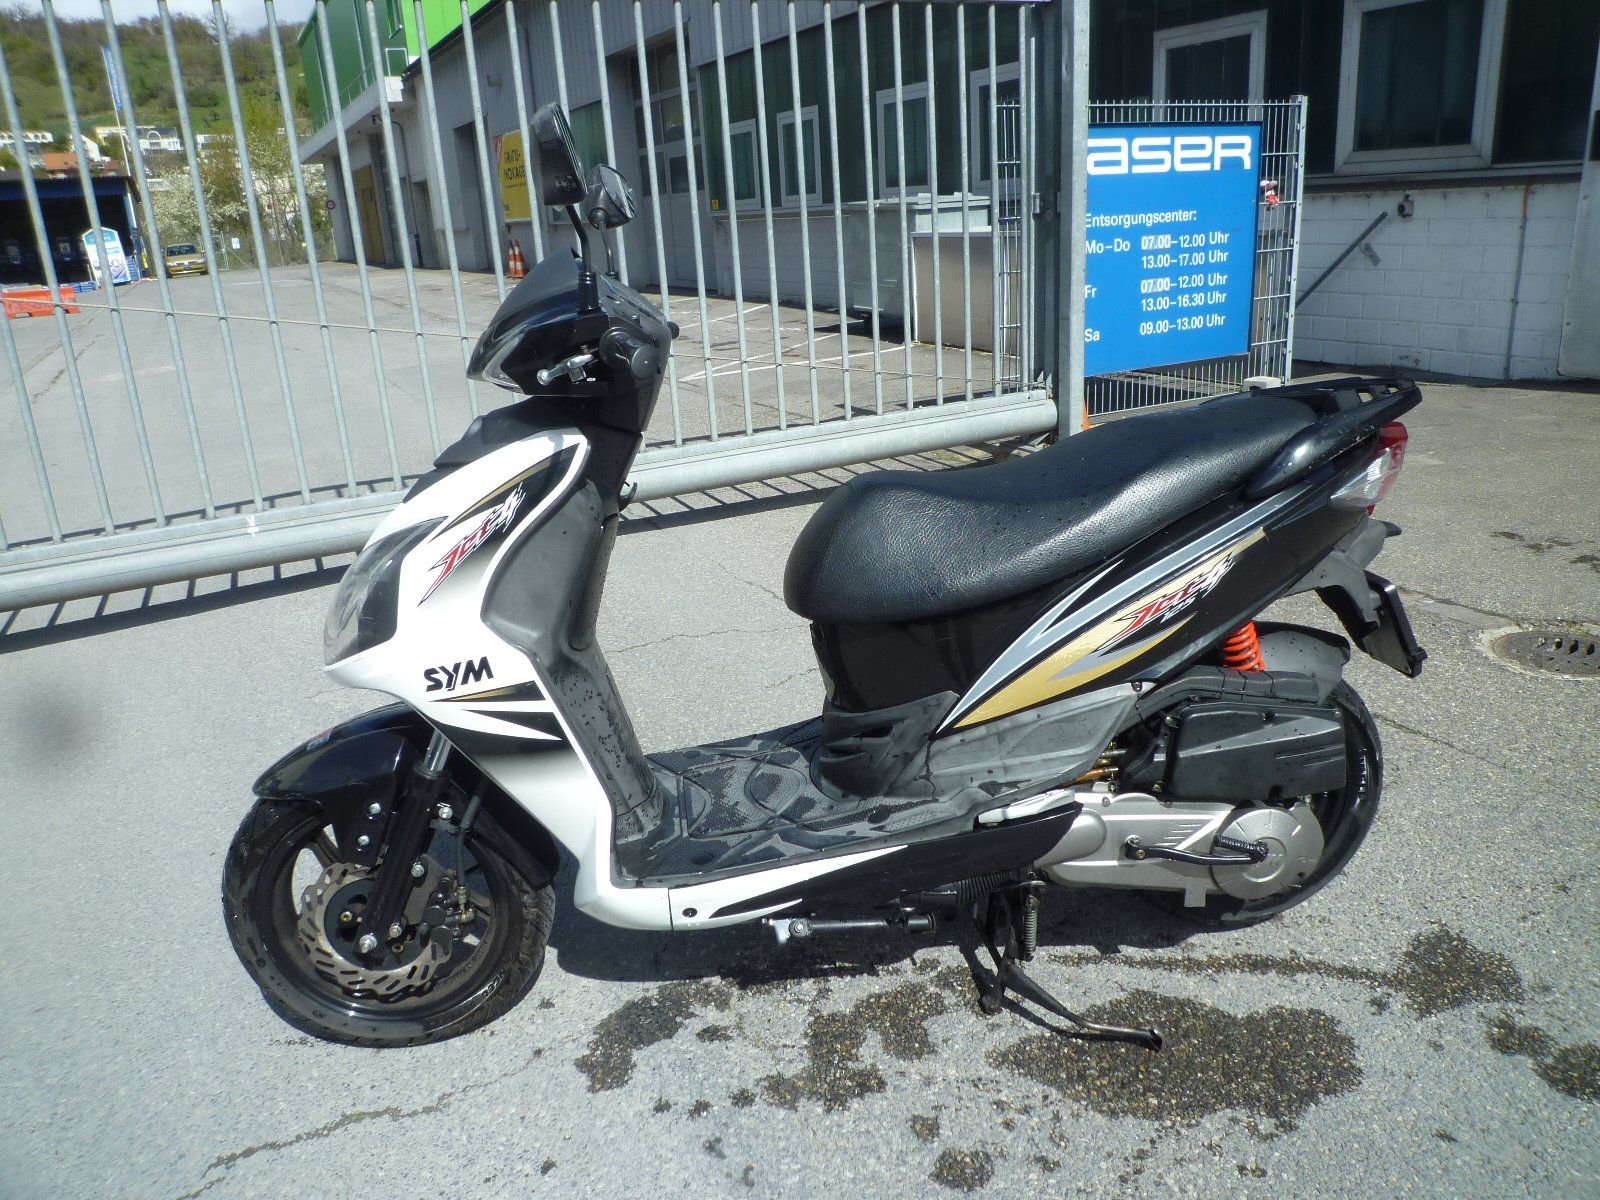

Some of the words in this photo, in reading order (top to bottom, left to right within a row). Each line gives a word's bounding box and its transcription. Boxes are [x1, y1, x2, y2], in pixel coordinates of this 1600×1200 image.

[1085, 210, 1197, 229] Entsorgungscenter:
[1209, 230, 1229, 245] Uhr
[1141, 252, 1205, 269] 13.00-17.00
[1208, 249, 1229, 263] Uhr
[1084, 284, 1098, 299] Fr
[1207, 272, 1228, 286] Uhr
[1141, 293, 1205, 312] 13.00-16.30
[1207, 290, 1227, 304] Uhr
[1084, 328, 1101, 342] Sa
[1139, 316, 1204, 336] 09.00-13.00
[1206, 313, 1226, 327] Uhr
[1160, 596, 1196, 624] 125
[423, 655, 495, 693] SYM
